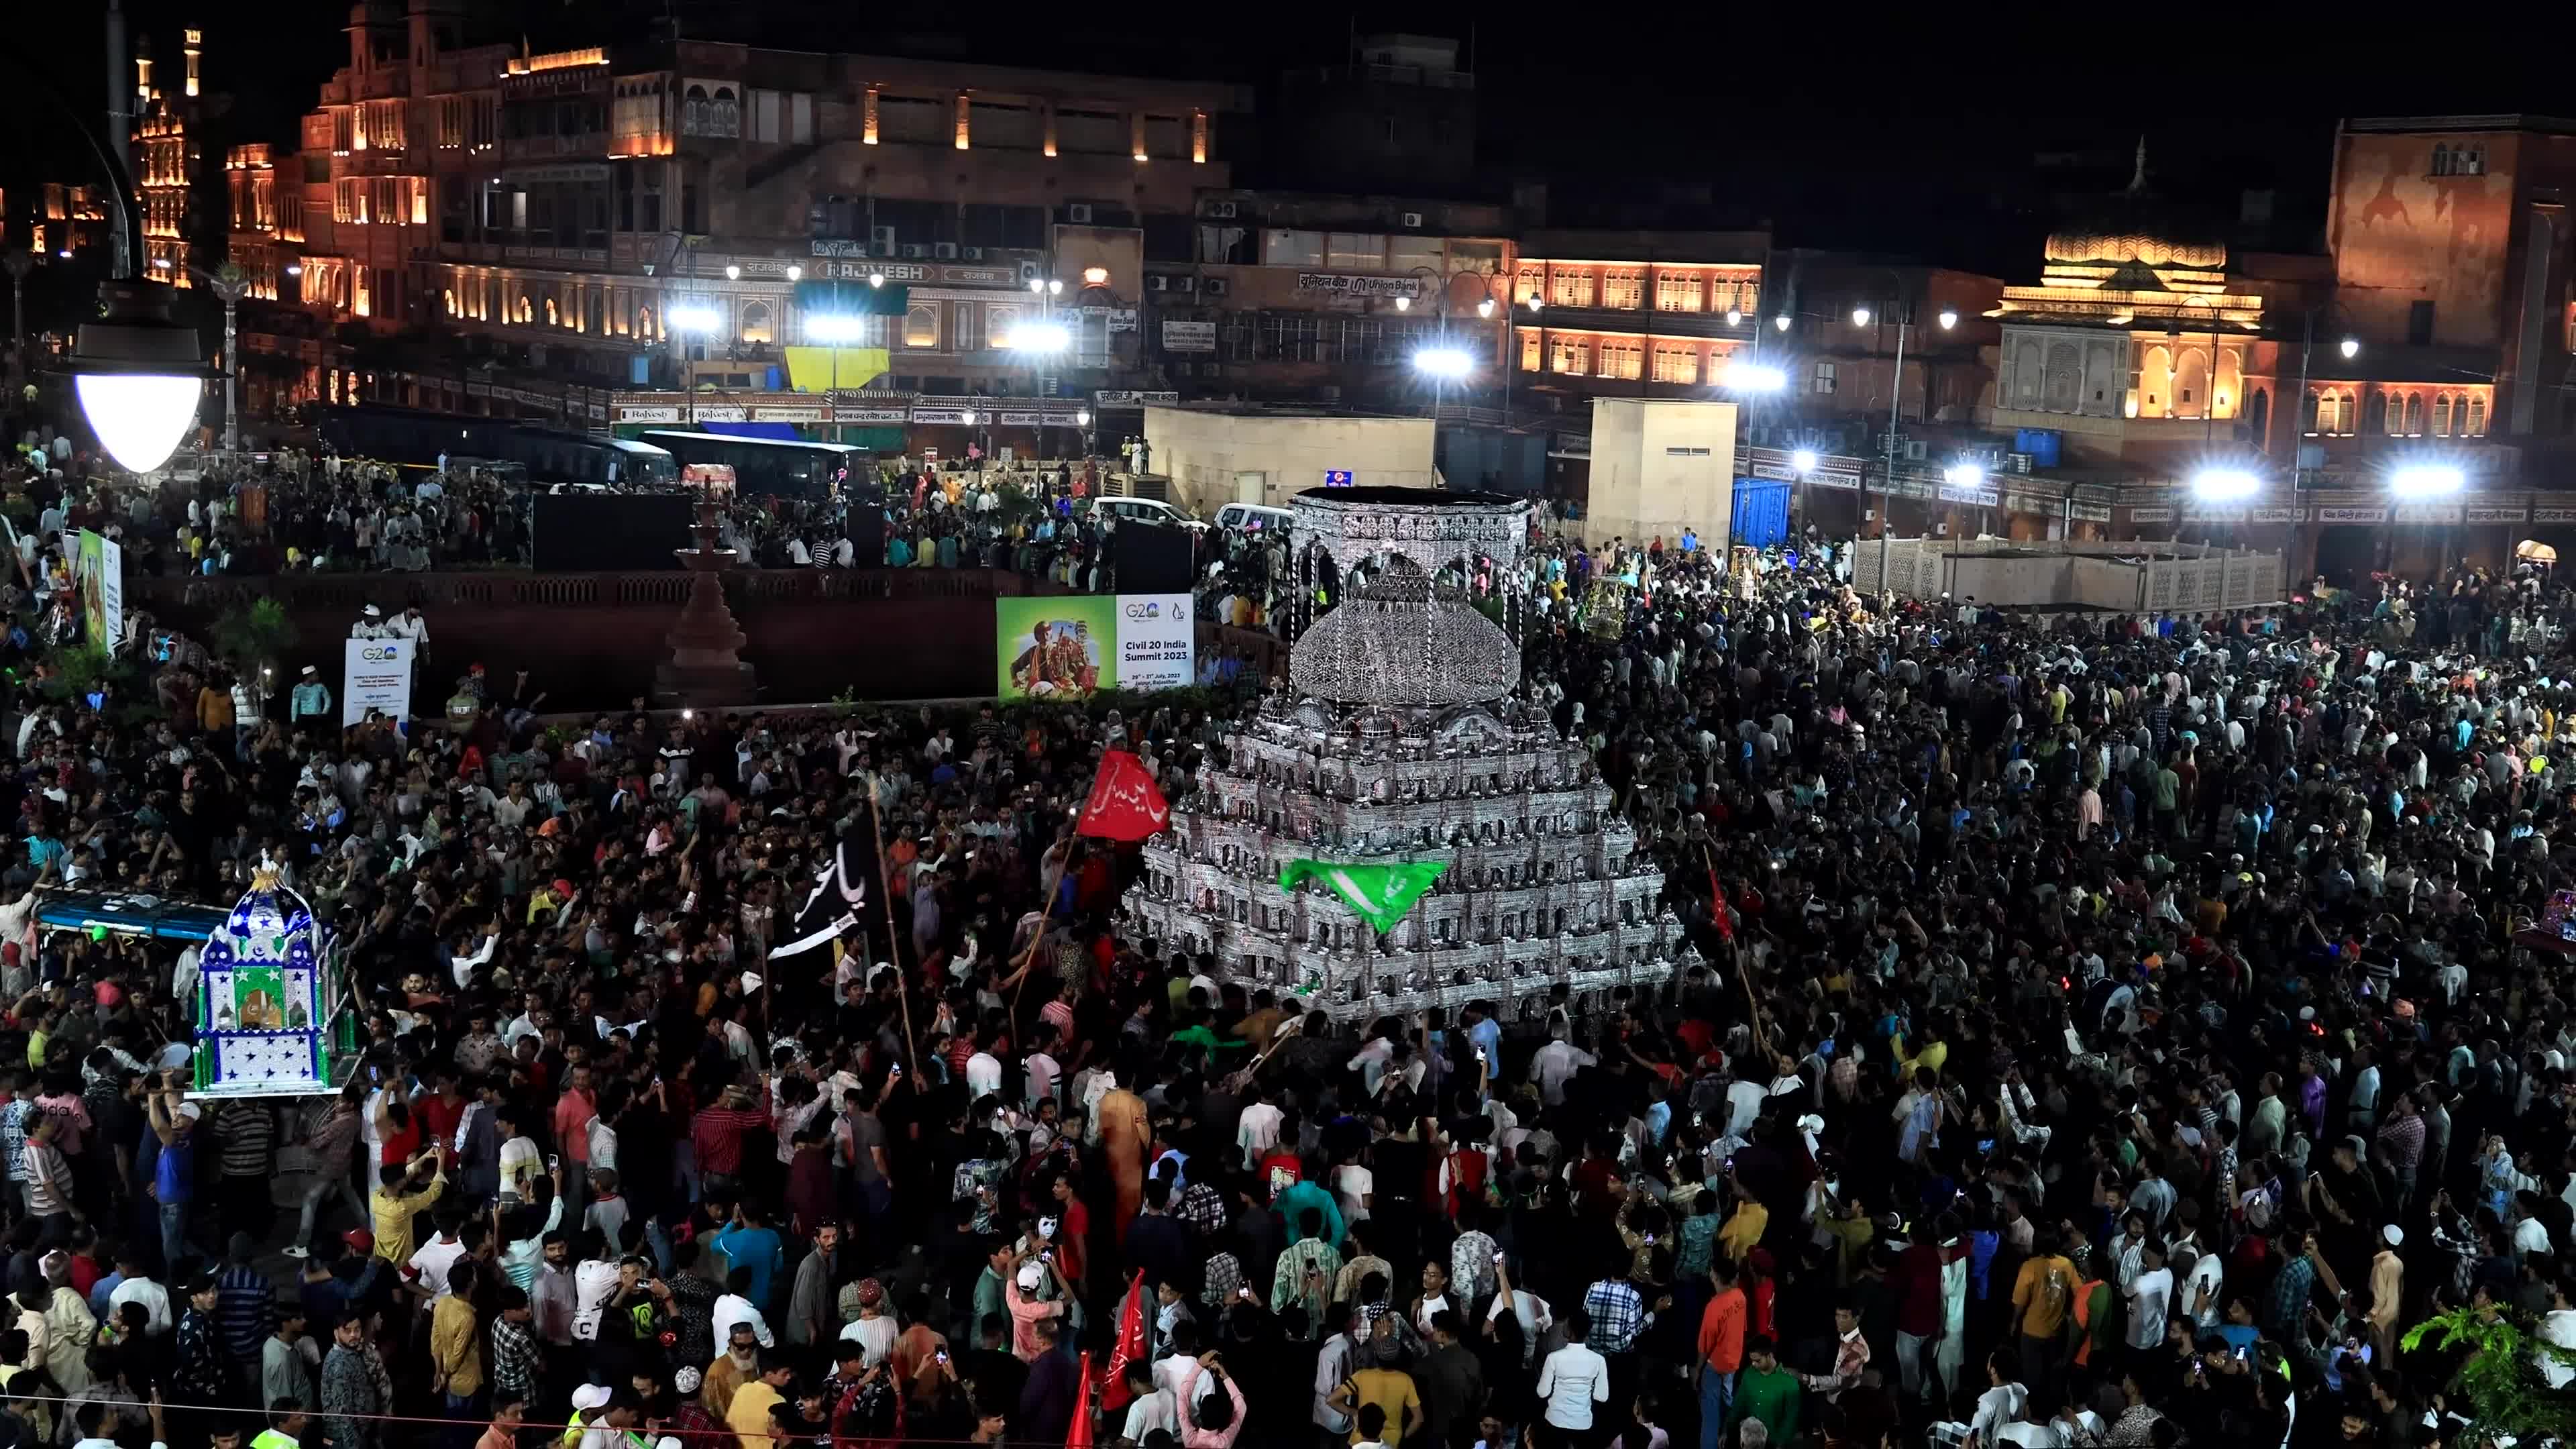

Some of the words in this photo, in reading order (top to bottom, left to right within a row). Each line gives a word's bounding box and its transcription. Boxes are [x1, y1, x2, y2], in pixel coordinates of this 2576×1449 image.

[1368, 280, 1394, 290] Union
[1395, 280, 1417, 290] Bank
[1126, 641, 1146, 650] Civil
[1148, 641, 1161, 649] 20
[1163, 640, 1187, 649] India
[1125, 652, 1161, 661] Summit
[1163, 651, 1187, 660] 2023
